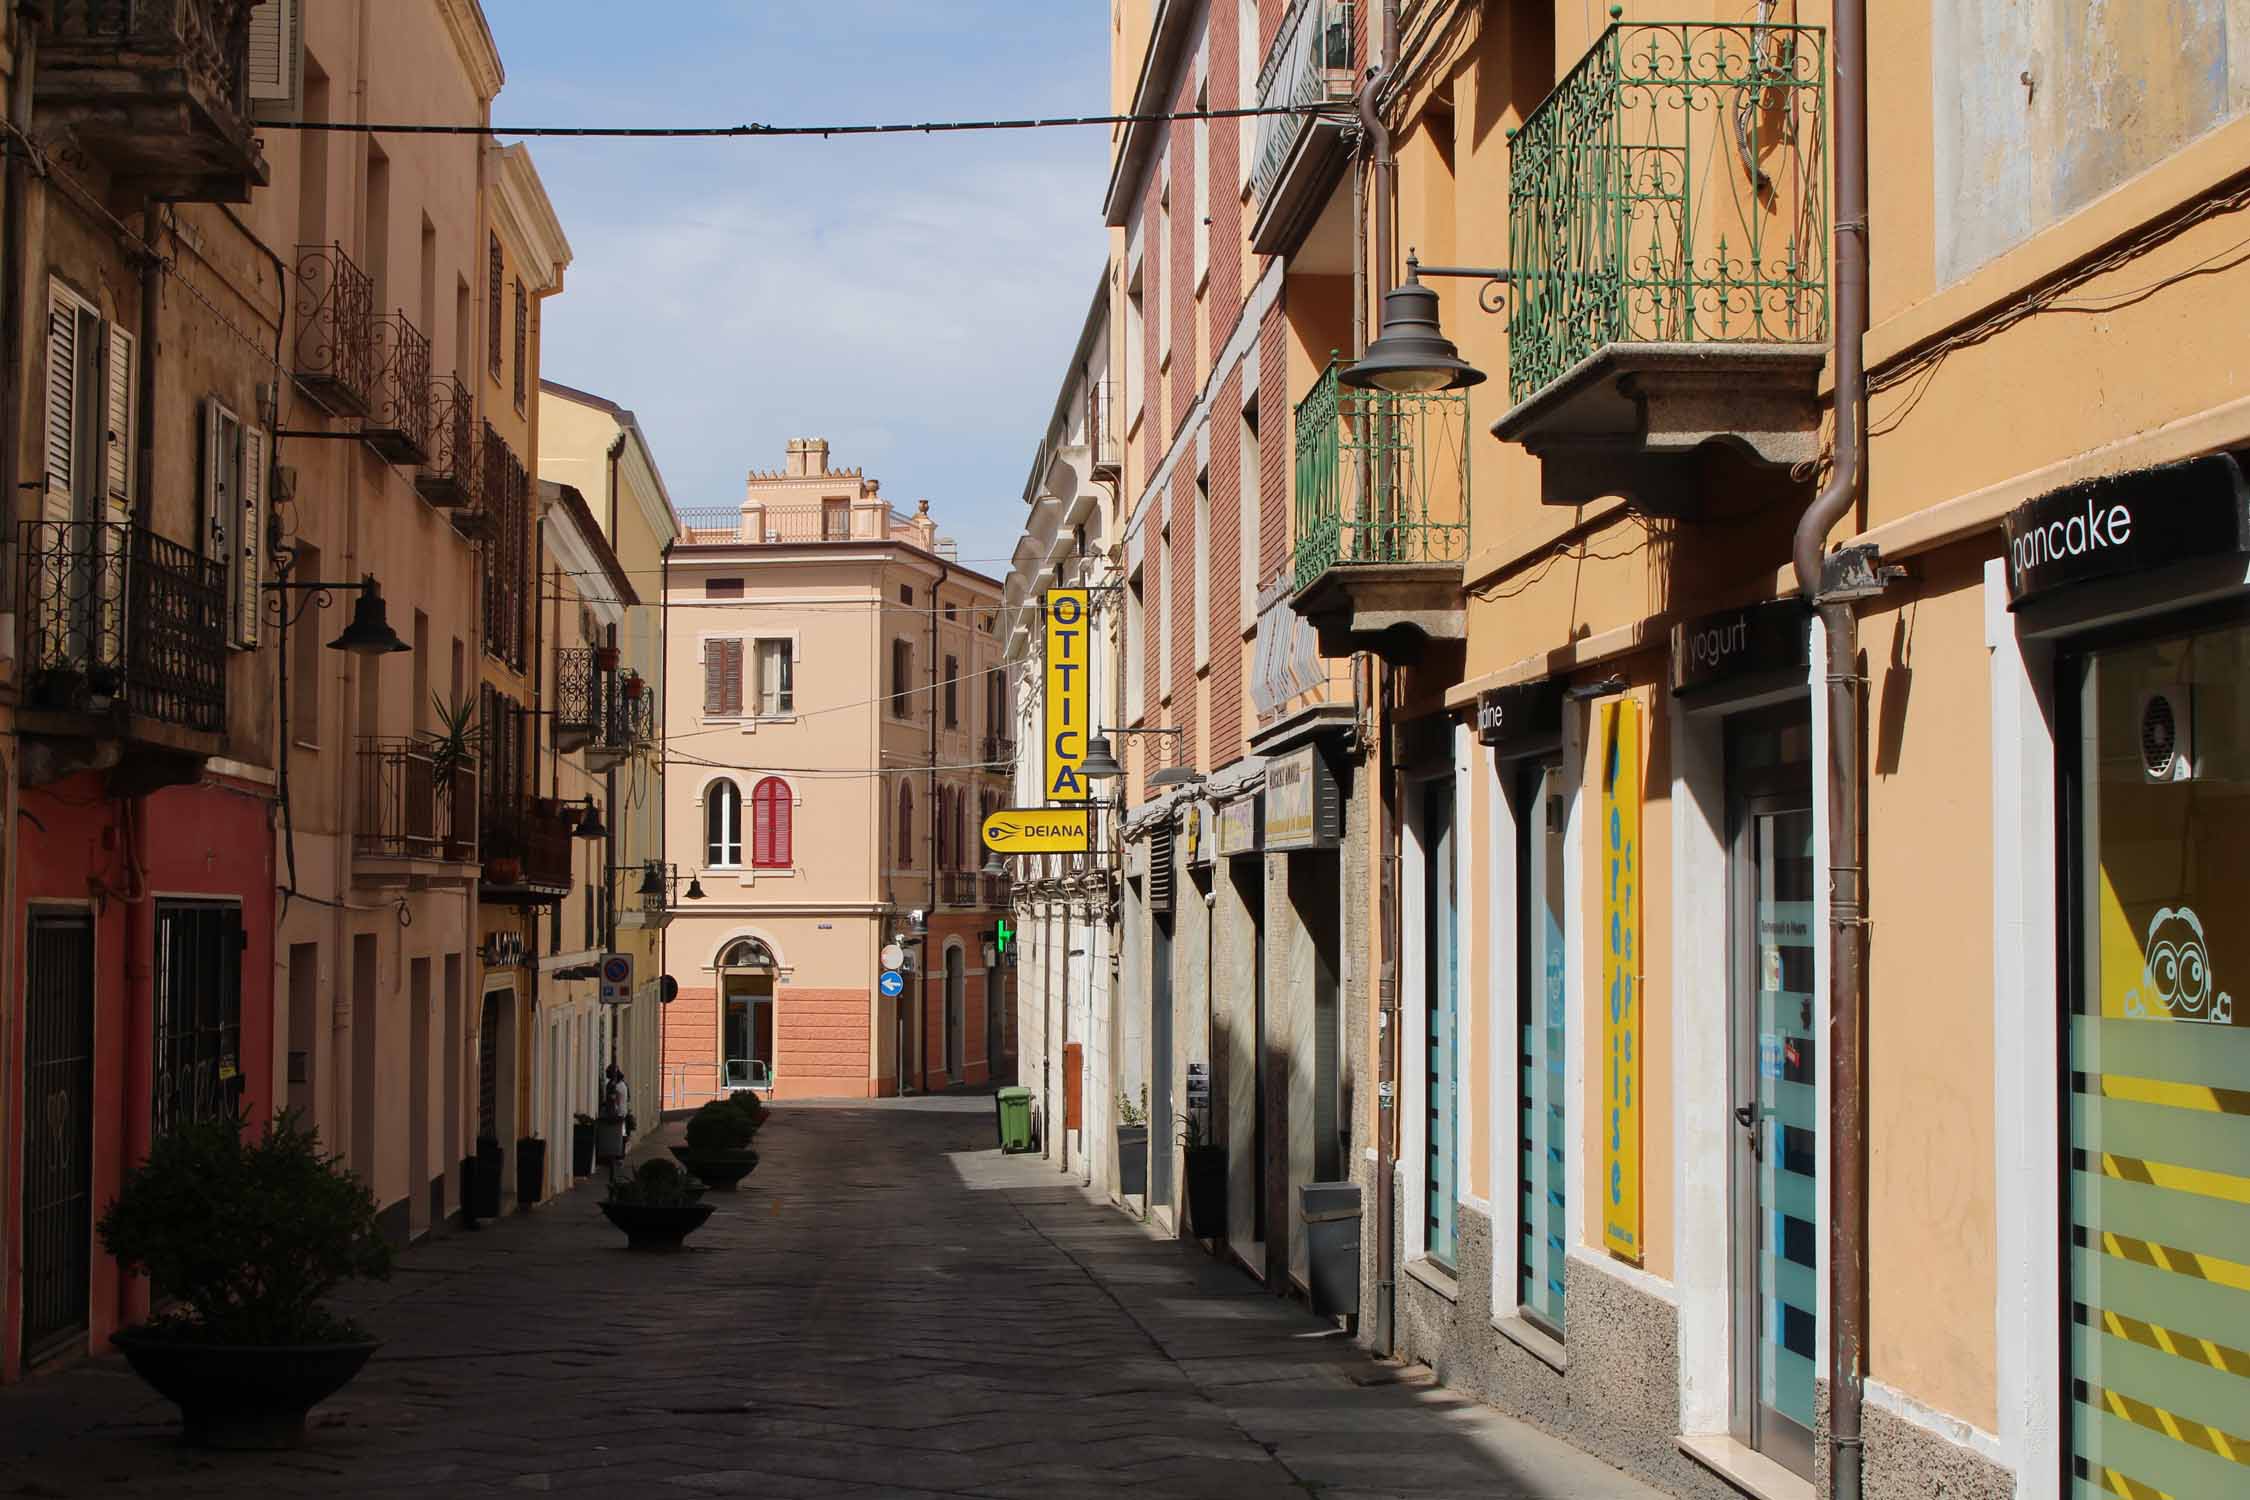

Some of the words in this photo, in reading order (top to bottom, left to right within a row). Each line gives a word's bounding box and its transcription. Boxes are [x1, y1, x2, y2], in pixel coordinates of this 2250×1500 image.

[2013, 499, 2131, 586] pancake
[1689, 614, 1746, 672] yogurt
[1052, 597, 1081, 793] OTTICA
[1025, 825, 1084, 837] DEIANA
[1625, 839, 1633, 1110] crepes
